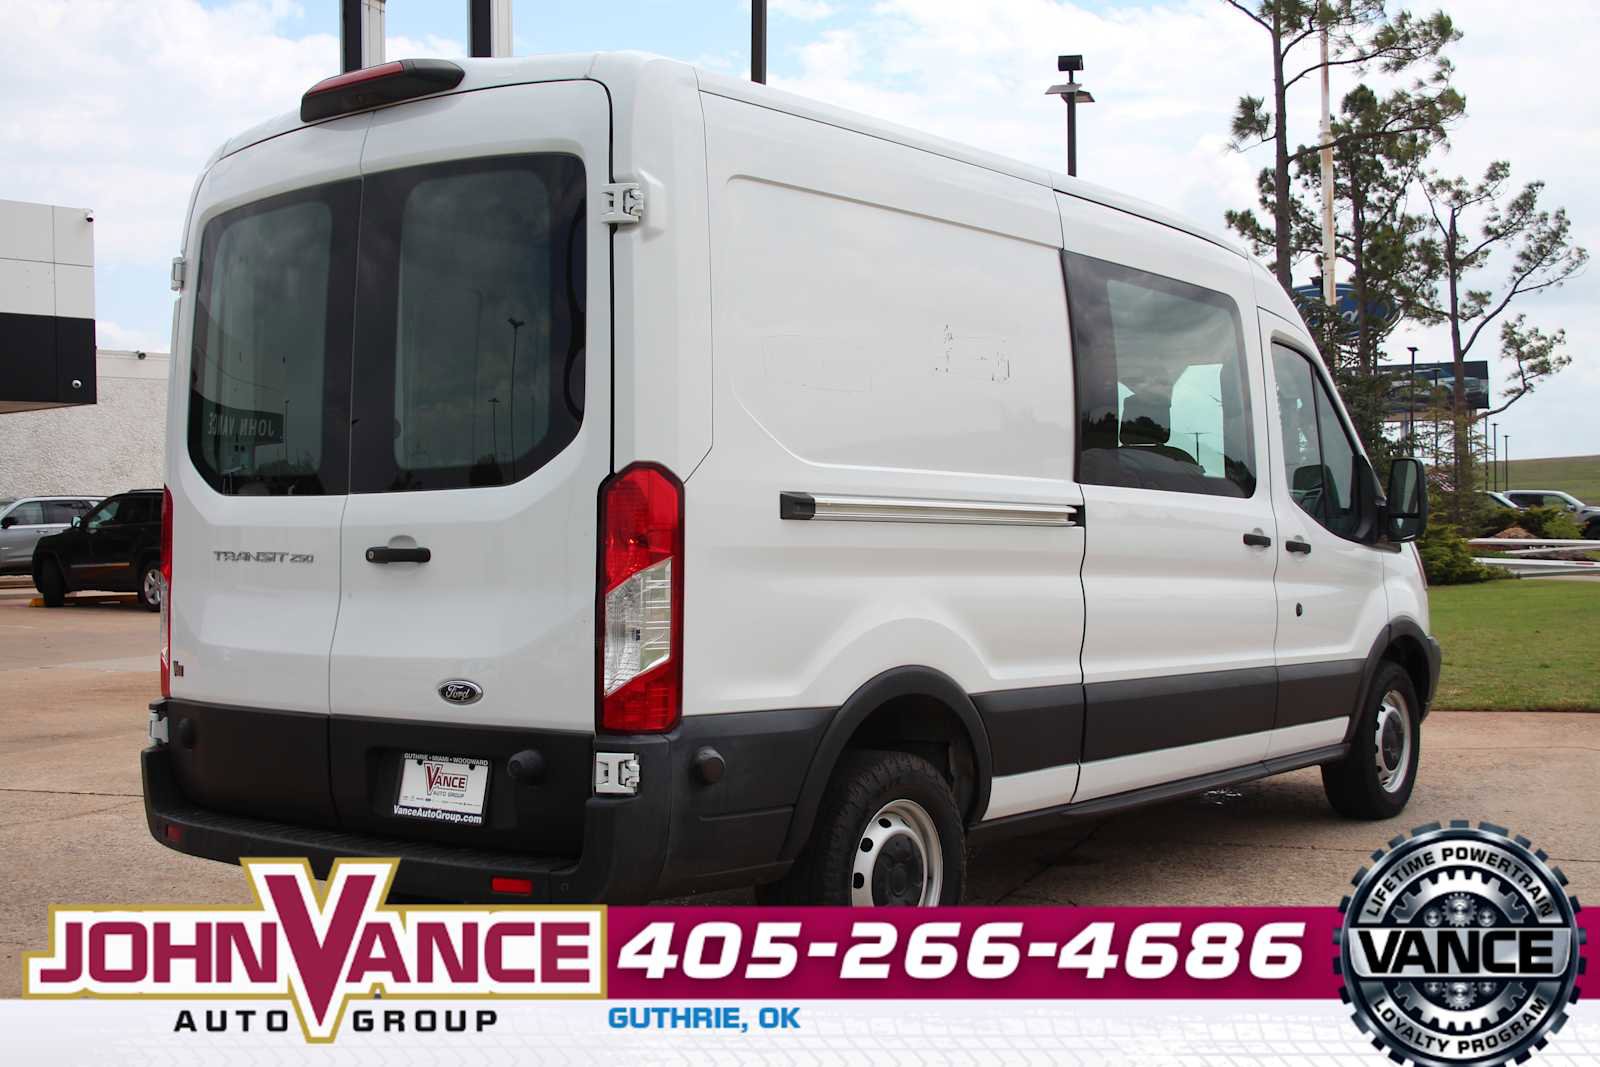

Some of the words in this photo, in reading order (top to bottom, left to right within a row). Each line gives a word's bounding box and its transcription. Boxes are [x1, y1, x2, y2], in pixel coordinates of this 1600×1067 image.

[213, 550, 289, 563] TRANSIT
[289, 553, 314, 563] 250
[453, 757, 489, 766] WOODWARD
[393, 804, 482, 824] VanceAutoGroup.com
